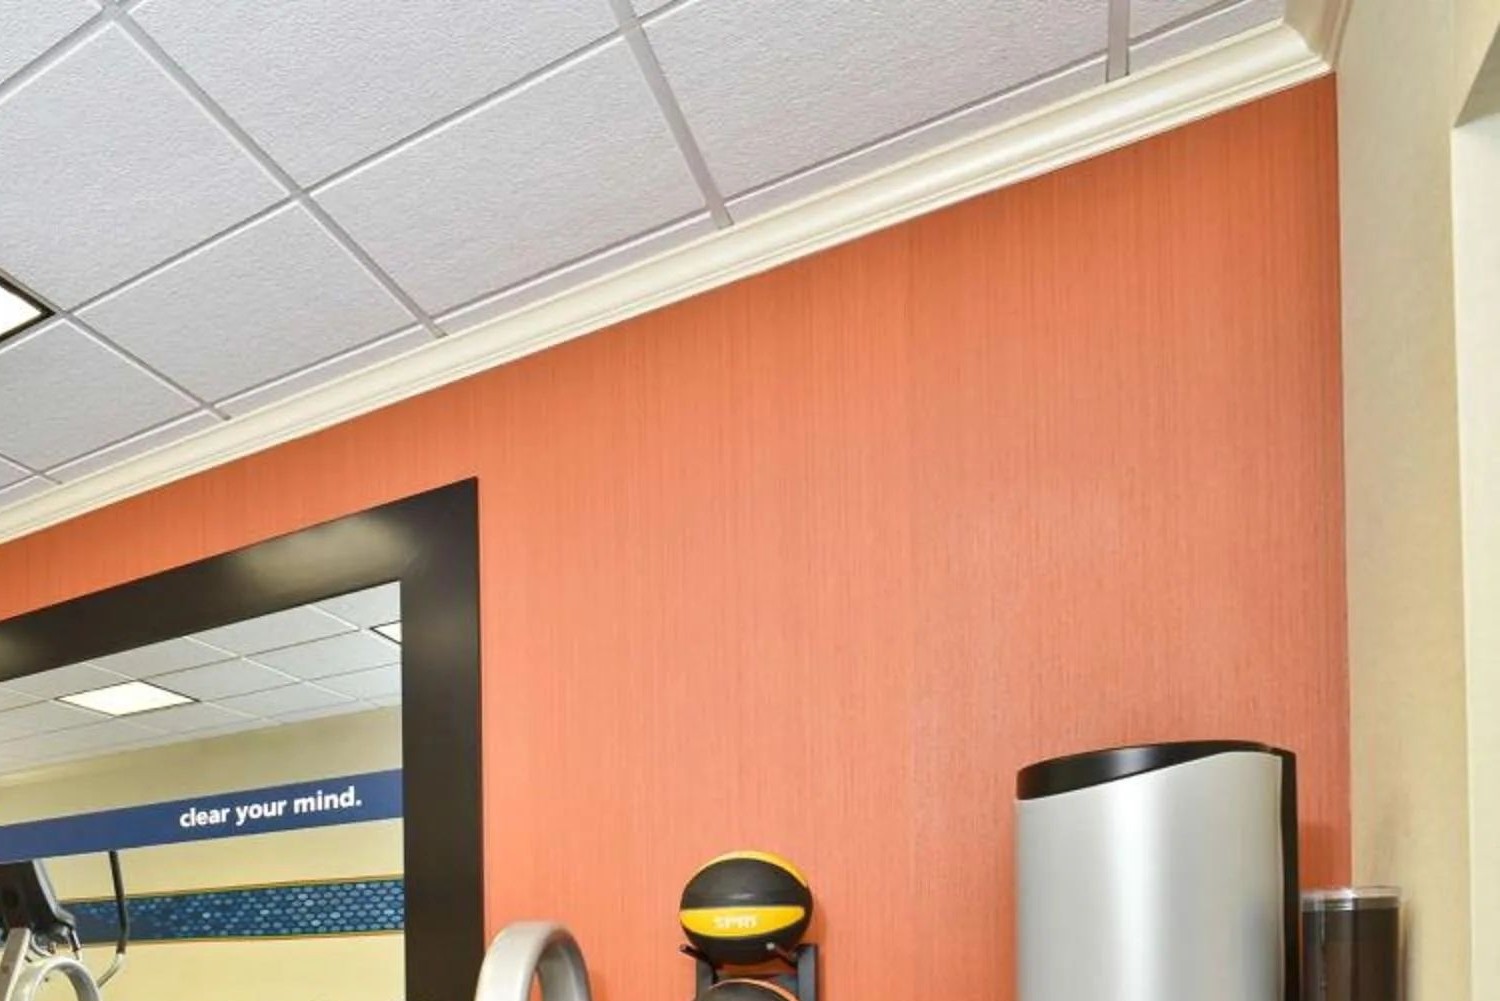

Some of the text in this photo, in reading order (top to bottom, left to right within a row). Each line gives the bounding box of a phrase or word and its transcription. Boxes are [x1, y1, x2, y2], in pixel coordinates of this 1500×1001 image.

[180, 785, 362, 827] clear your mind.
